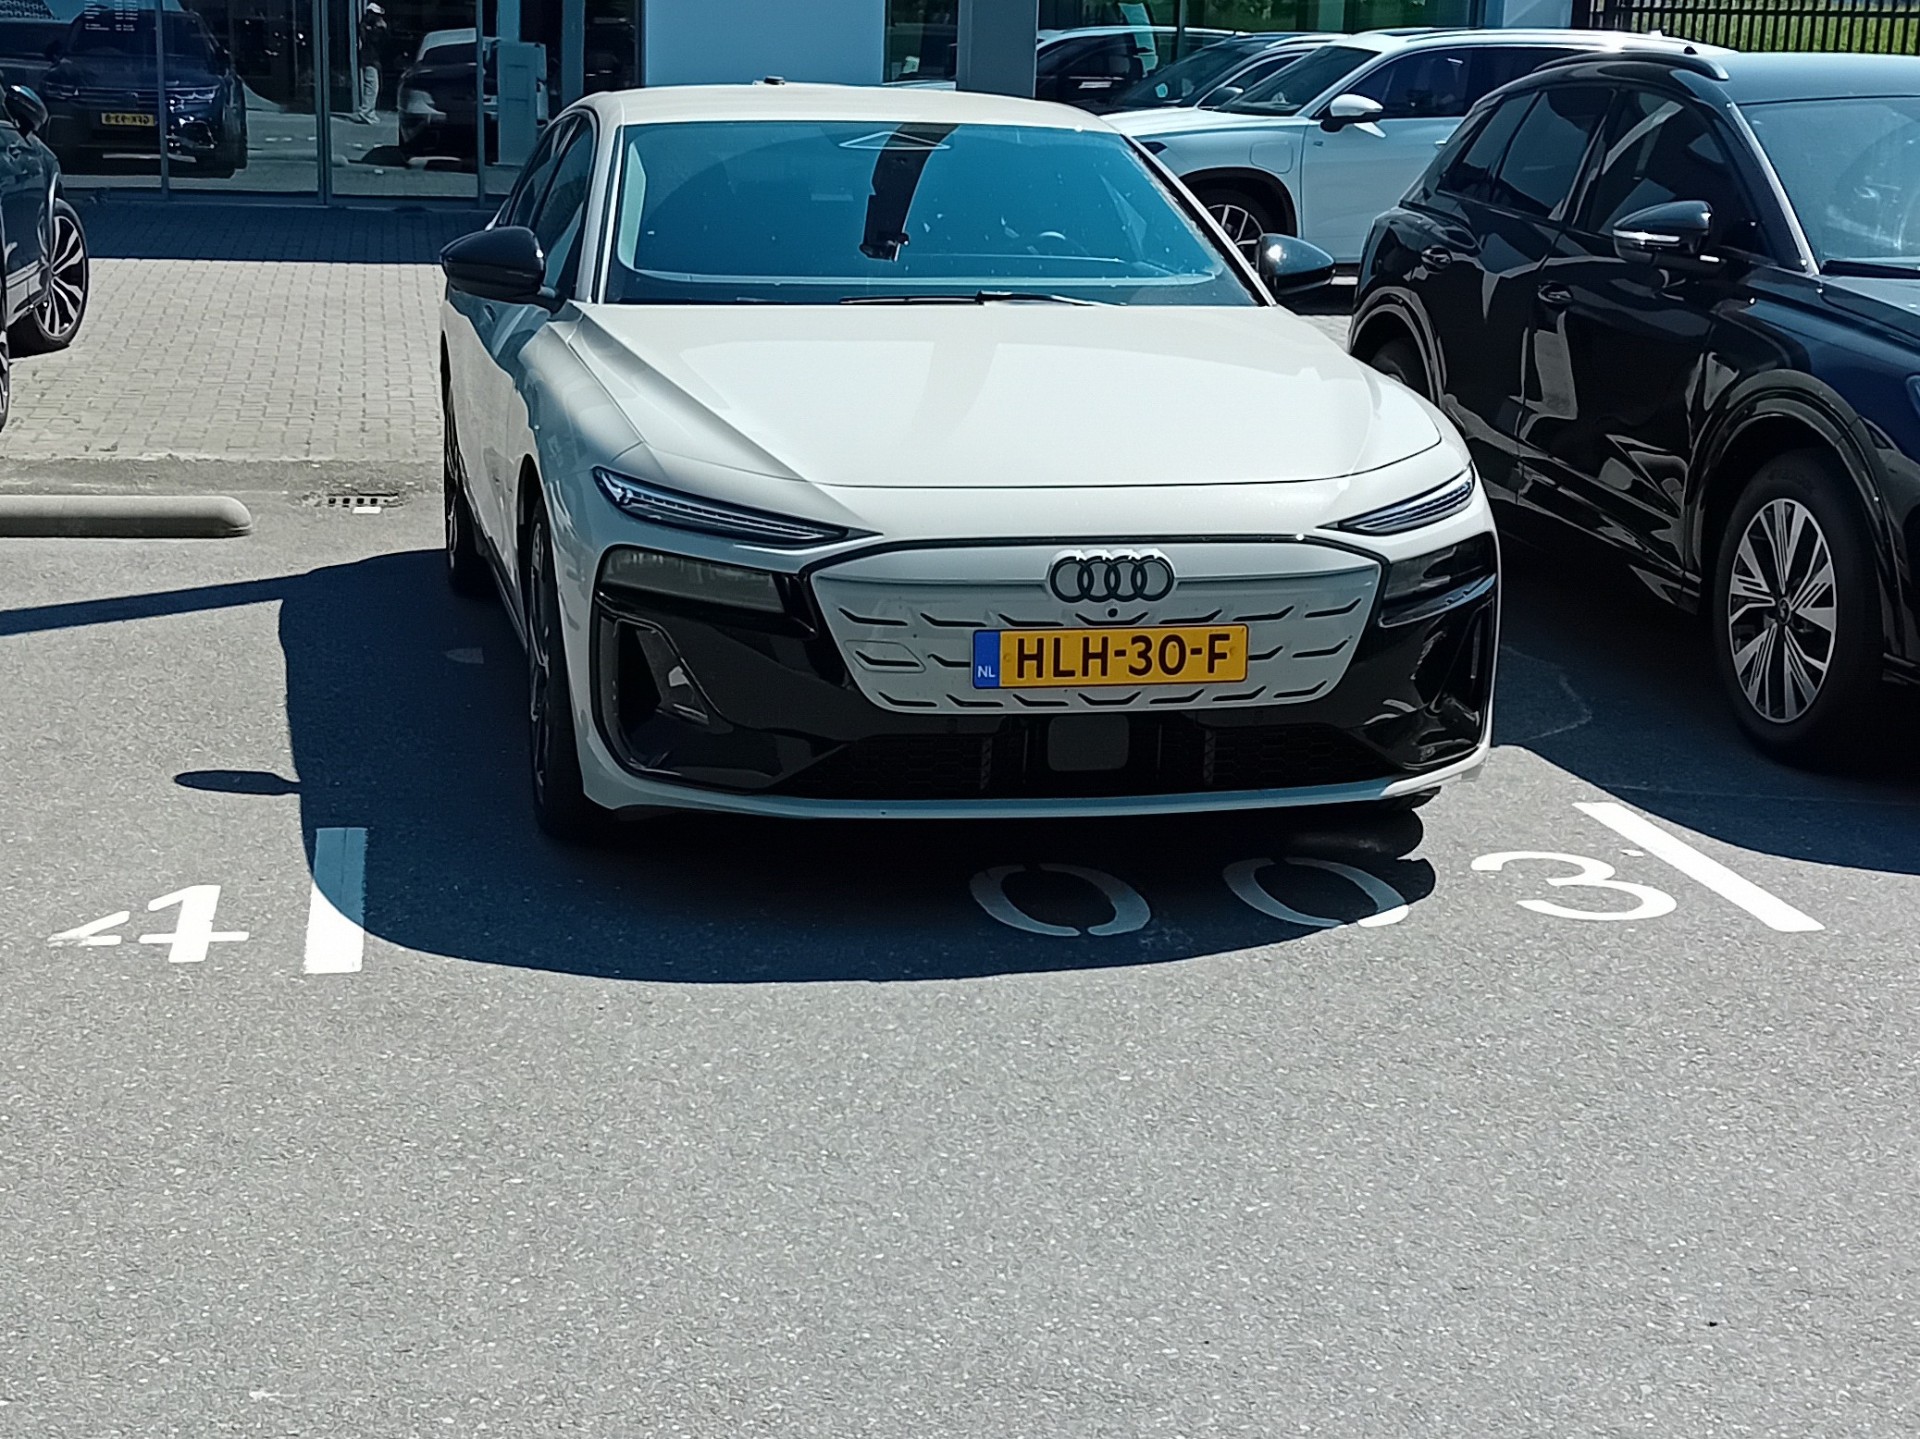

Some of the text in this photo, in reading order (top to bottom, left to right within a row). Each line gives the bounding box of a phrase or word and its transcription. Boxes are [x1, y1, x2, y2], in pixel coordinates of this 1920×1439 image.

[977, 665, 996, 678] NL
[1016, 634, 1231, 678] HLH-30-F
[47, 884, 250, 963] 4
